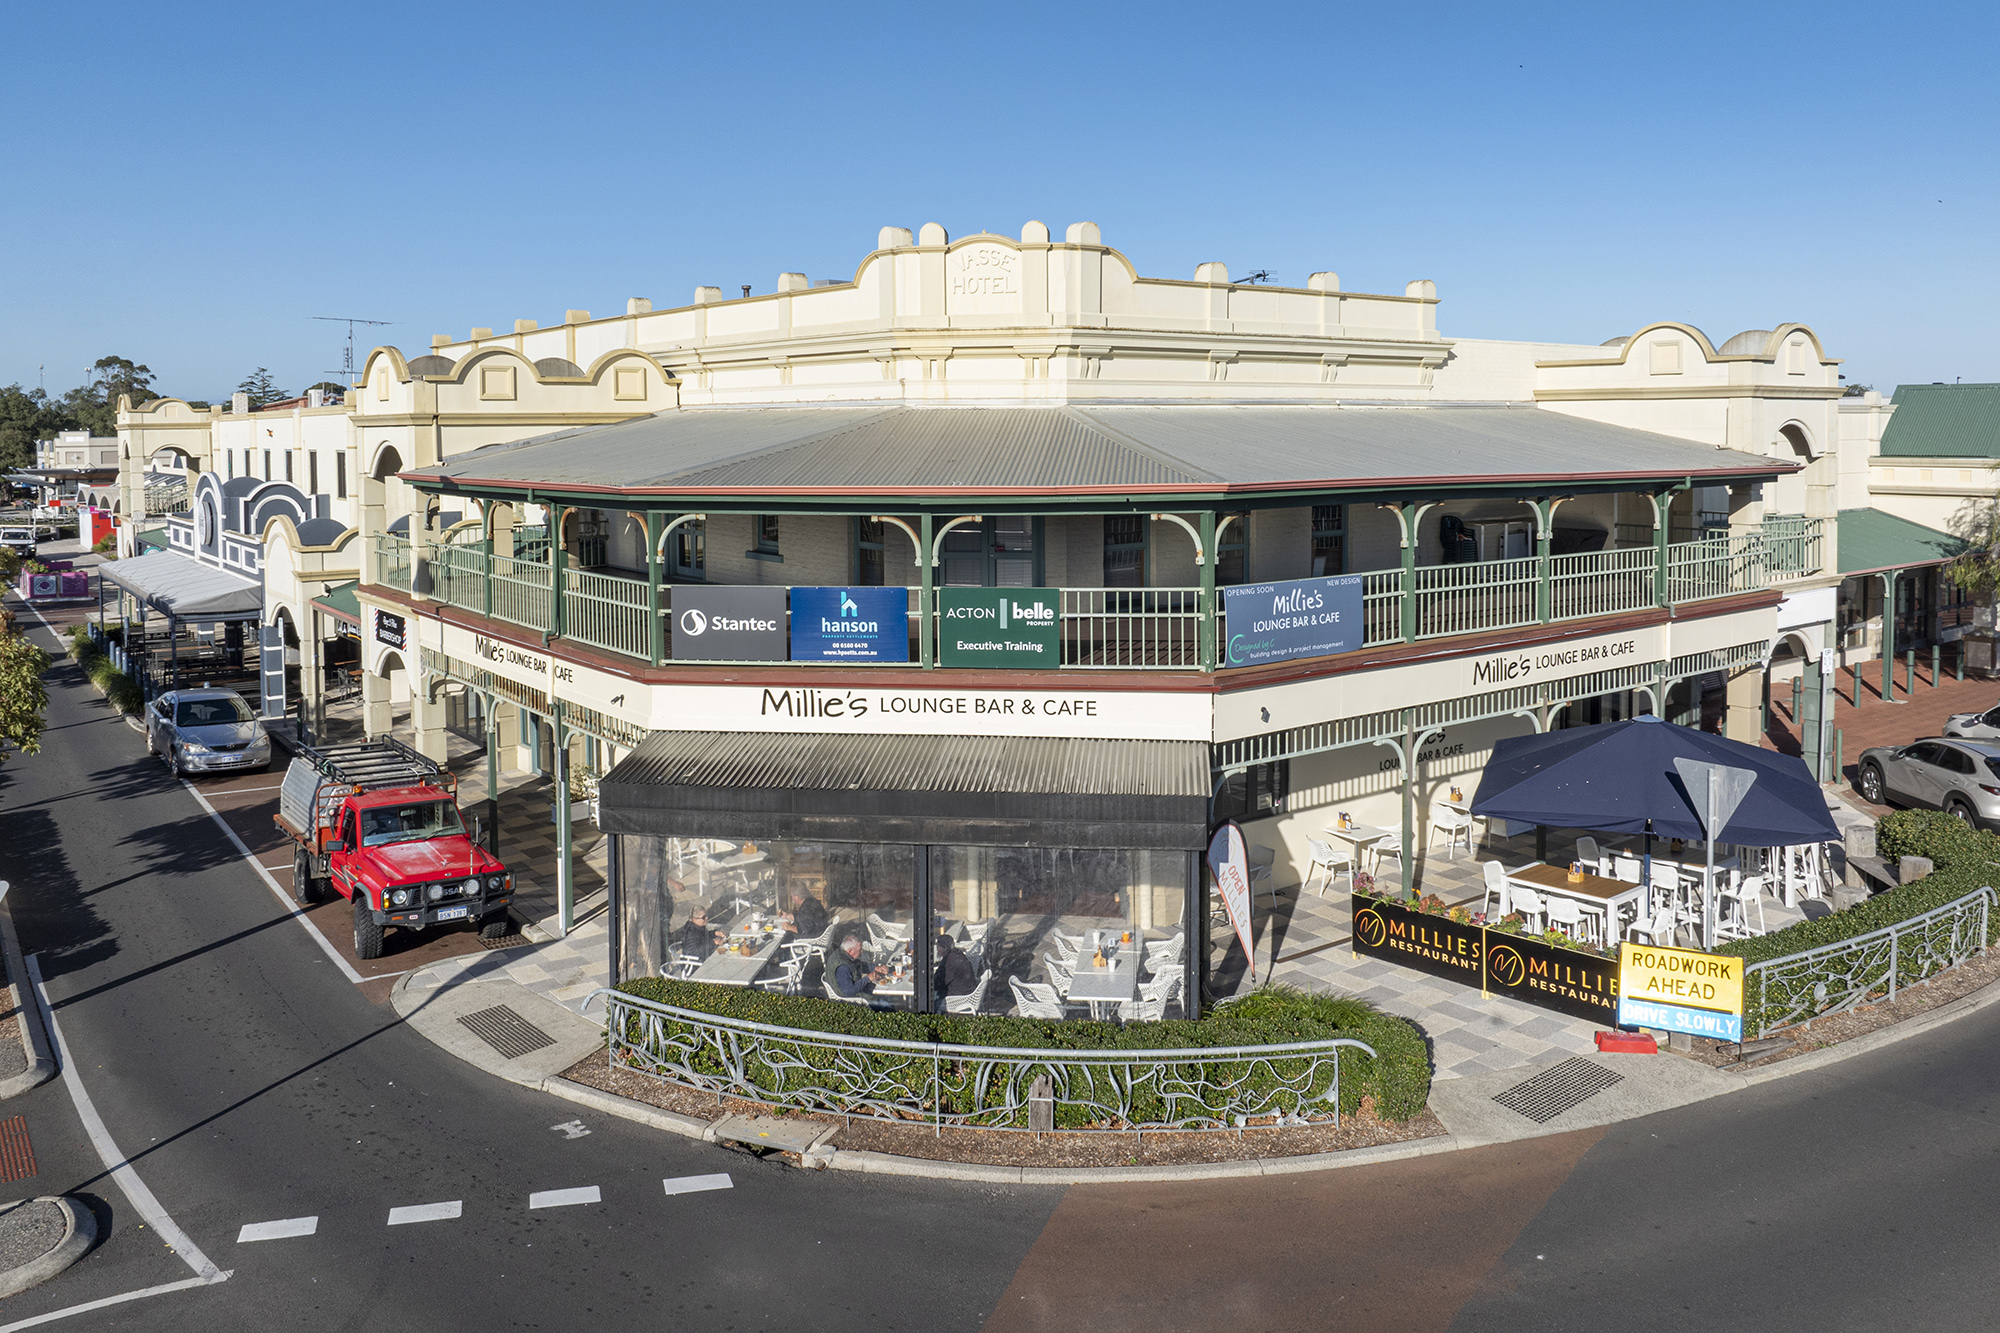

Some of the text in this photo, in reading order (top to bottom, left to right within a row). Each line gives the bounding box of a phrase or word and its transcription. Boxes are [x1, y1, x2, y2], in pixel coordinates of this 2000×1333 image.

[950, 249, 1016, 273] VASSE
[953, 276, 1017, 295] HOTEL
[1227, 586, 1274, 597] OPENING SOON
[1326, 577, 1361, 587] NEW DESIGN
[946, 607, 995, 619] ACTON
[1012, 602, 1054, 619] belle
[1273, 588, 1324, 615] Millie's
[711, 616, 777, 631] Stantec
[821, 617, 878, 632] hanson
[1253, 612, 1340, 632] LOUNGE BAR & CAFE
[957, 641, 1043, 653] Executive Training
[1234, 638, 1261, 653] Designed
[1261, 639, 1269, 651] by
[1250, 650, 1270, 659] building
[1271, 647, 1288, 656] design
[1293, 644, 1312, 654] project
[1312, 641, 1344, 650] management
[475, 634, 573, 683] Millie's LOUNGE BAR CAFE
[1473, 640, 1635, 686] Millie's LOUNGE BAR & CAFE
[761, 688, 1097, 718] Millie's LOUNGE BAR & CAFE
[1418, 751, 1433, 763] BAR
[1435, 748, 1441, 759] &
[1443, 744, 1464, 757] CAFE
[1228, 865, 1246, 896] OPEN
[1219, 870, 1248, 928] MILLIES
[1389, 919, 1480, 958] MILLIES
[1389, 938, 1479, 971] RESTAURANT
[1632, 952, 1731, 980] ROADWORK
[1529, 957, 1618, 996] MILLIE
[1646, 976, 1716, 1000] AHEAD
[1529, 977, 1617, 1010] RESTAURA
[1623, 1003, 1736, 1035] DRIVE SLOWLY
